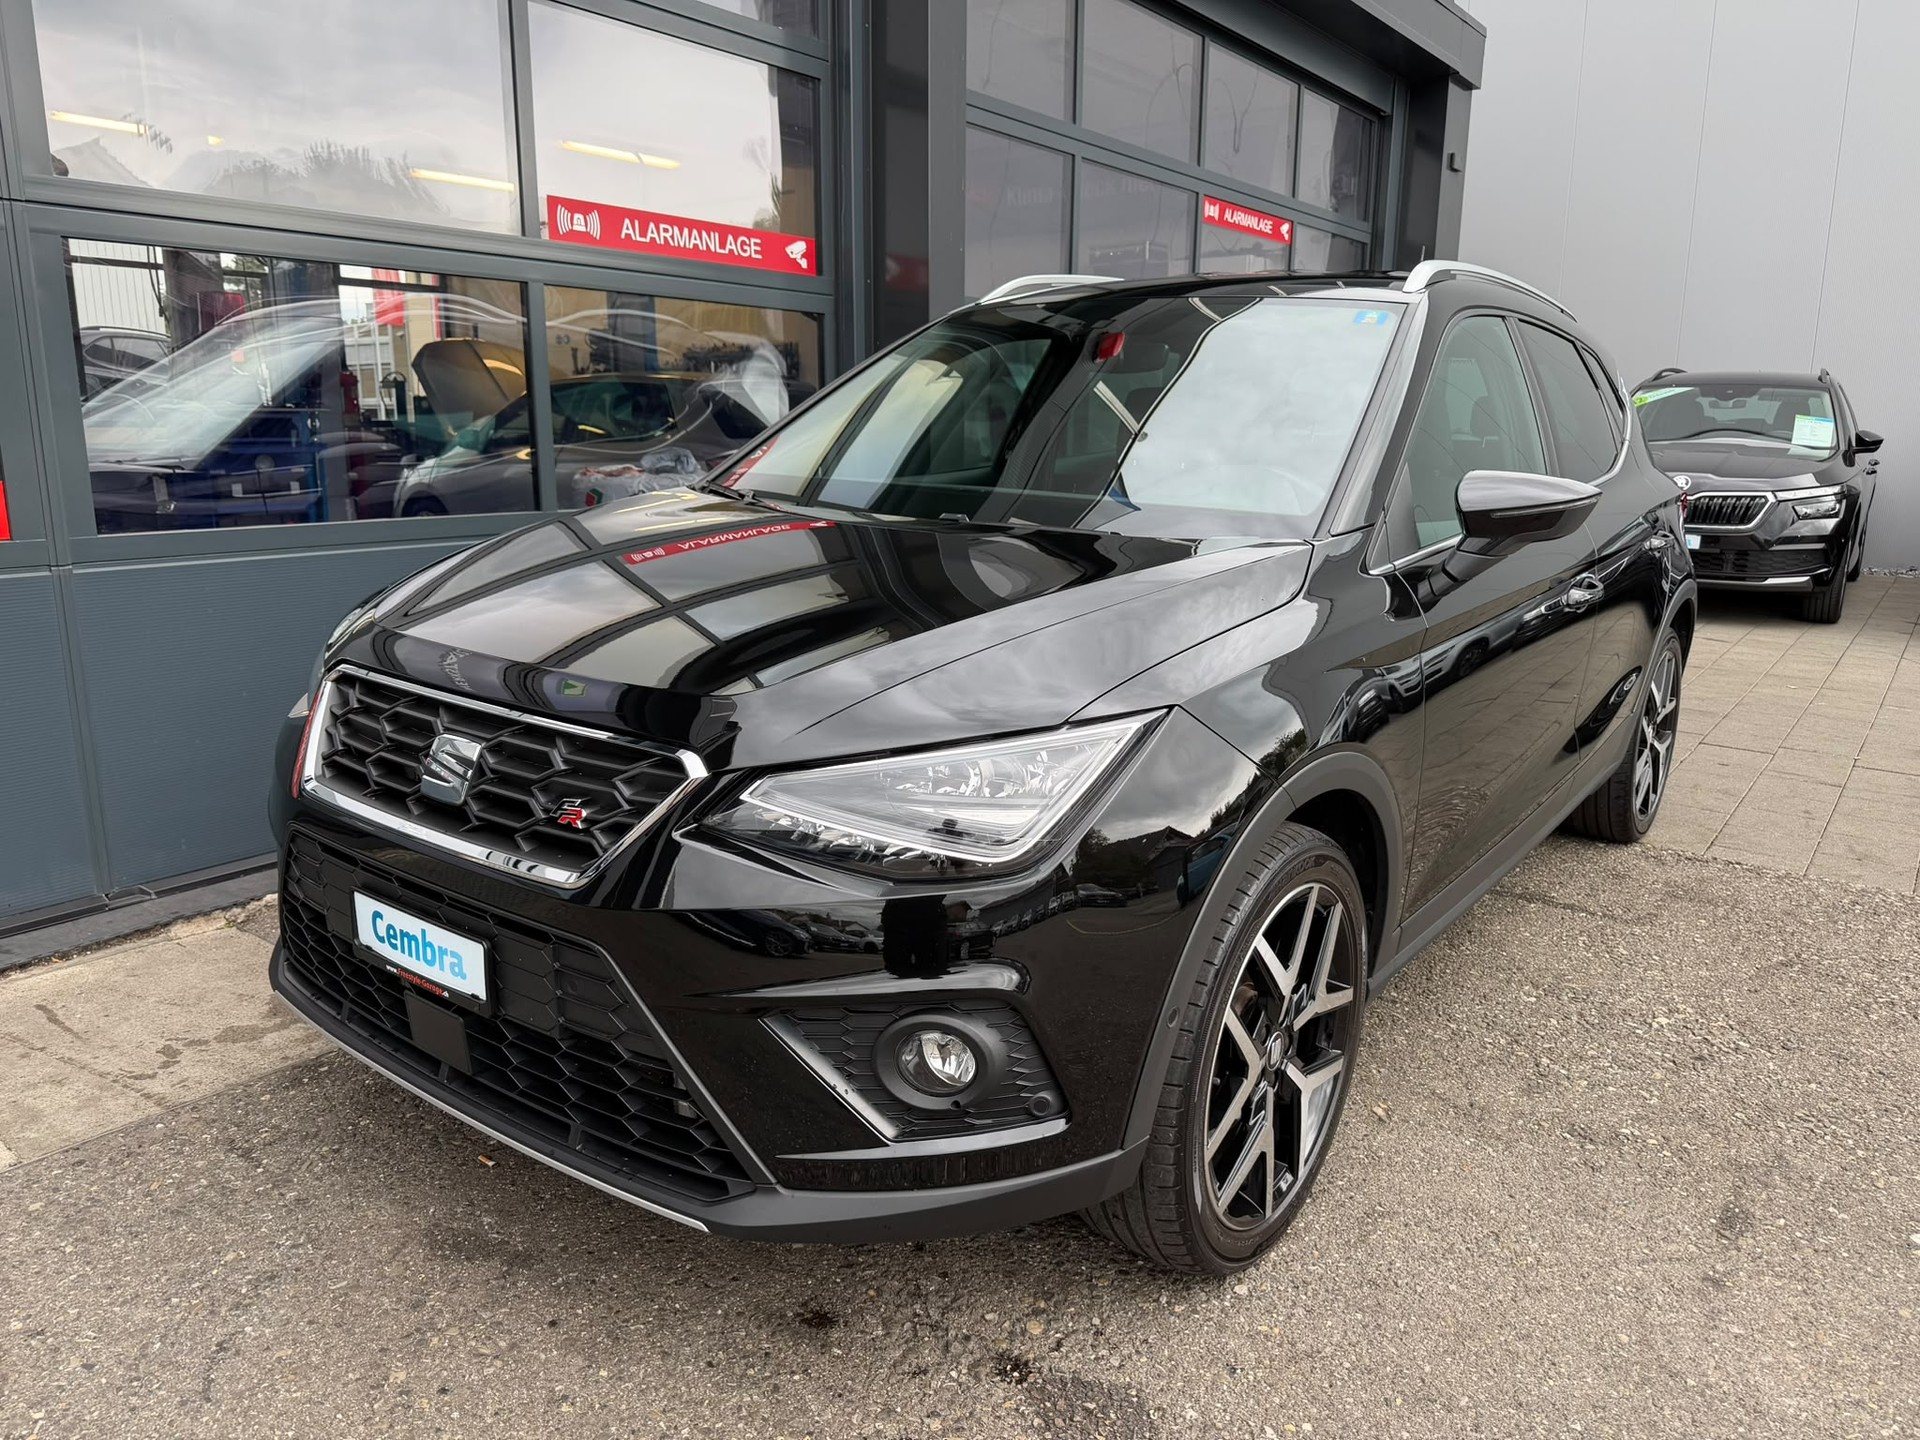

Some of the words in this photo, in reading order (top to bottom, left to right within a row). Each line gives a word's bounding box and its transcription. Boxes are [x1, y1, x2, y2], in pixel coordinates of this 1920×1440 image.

[620, 217, 763, 259] ALARMANLAGE
[1223, 208, 1273, 234] ALARMANLAGE
[549, 798, 587, 829] FR
[371, 910, 467, 981] Cembra
